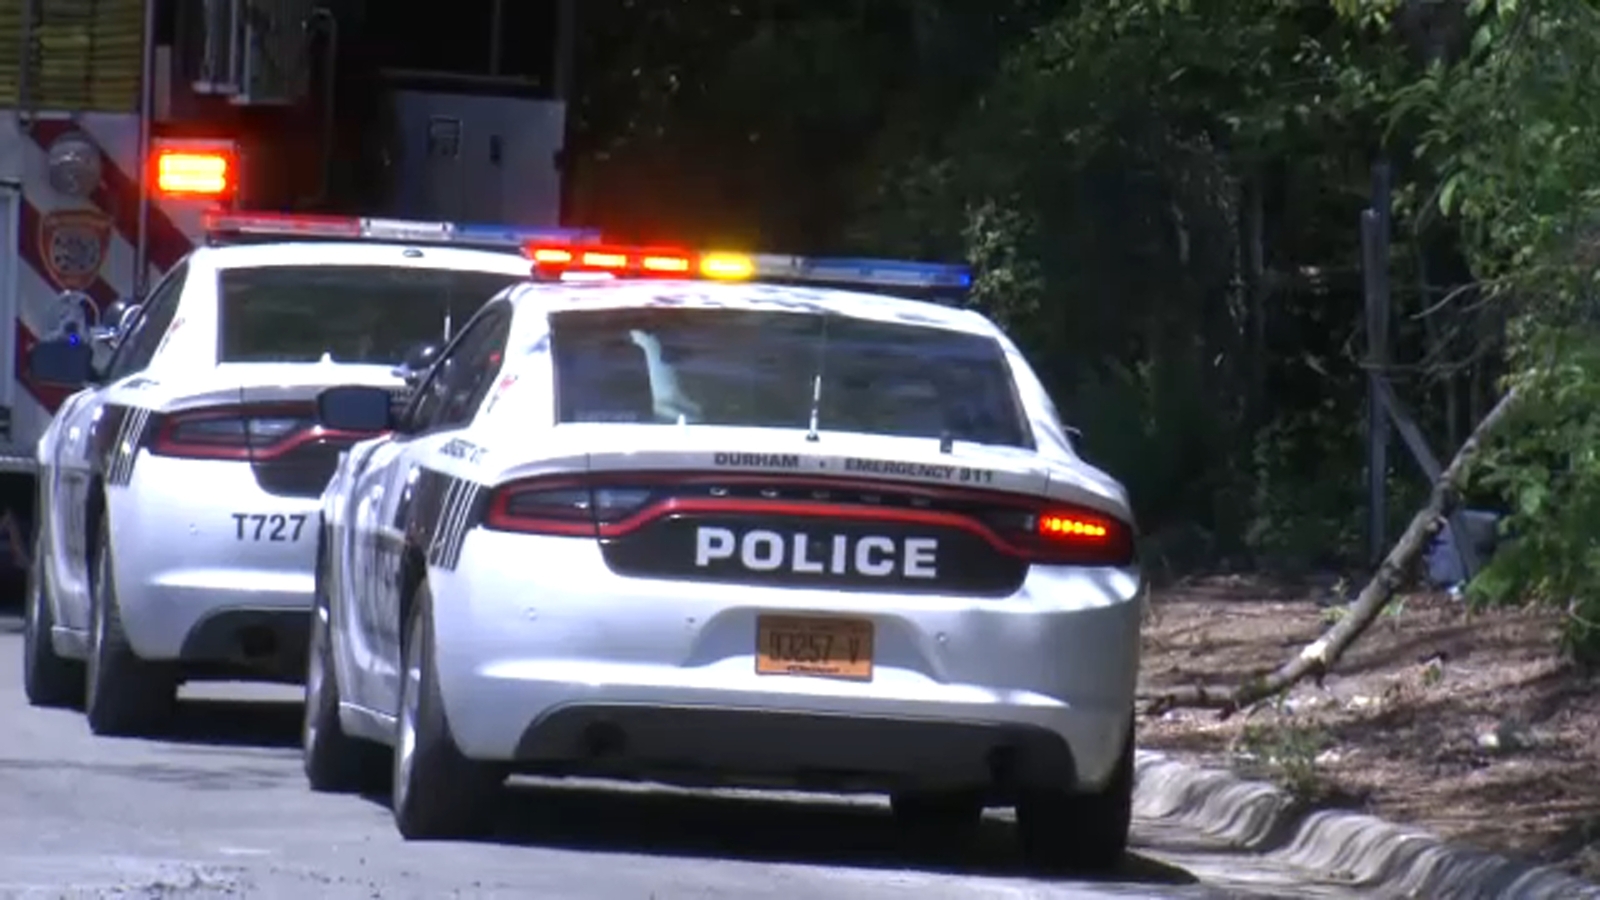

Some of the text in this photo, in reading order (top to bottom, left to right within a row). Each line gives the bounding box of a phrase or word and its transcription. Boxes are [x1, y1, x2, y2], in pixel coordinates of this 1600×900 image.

[714, 453, 994, 484] DURHAM EMERGENCY 911
[232, 513, 307, 542] T727
[696, 526, 938, 578] POLICE
